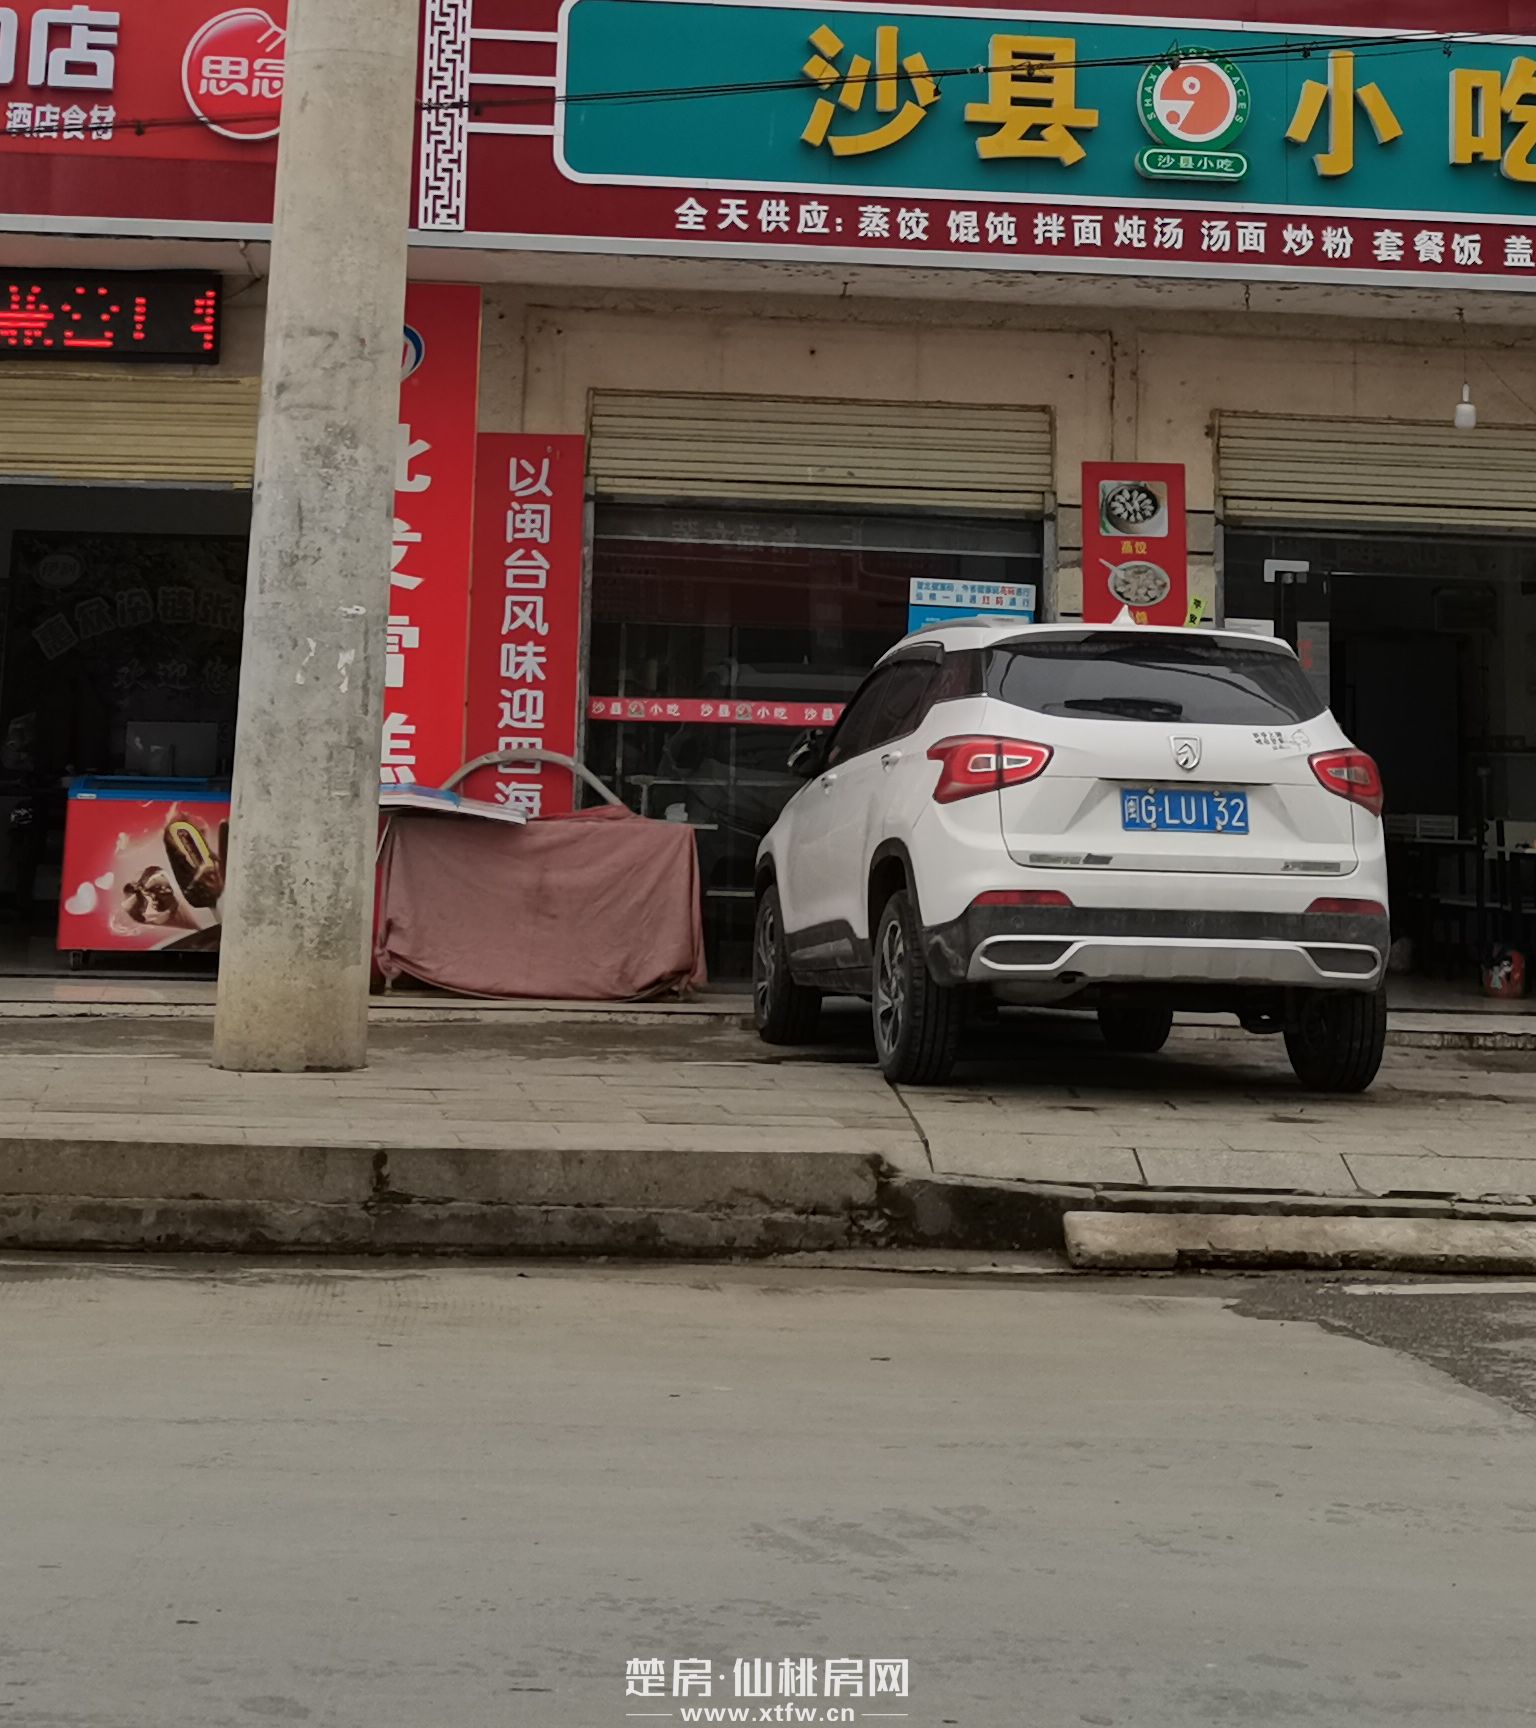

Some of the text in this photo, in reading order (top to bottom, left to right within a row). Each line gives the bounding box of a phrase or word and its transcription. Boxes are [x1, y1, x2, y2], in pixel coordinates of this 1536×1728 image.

[801, 24, 1099, 167] 沙县
[947, 209, 1018, 247] 馄饨
[1033, 212, 1103, 248] 拌面
[1114, 214, 1184, 250] 炖汤
[1200, 220, 1266, 254] 汤面
[1282, 224, 1354, 259] 炒粉
[1372, 229, 1482, 265] 套餐饭
